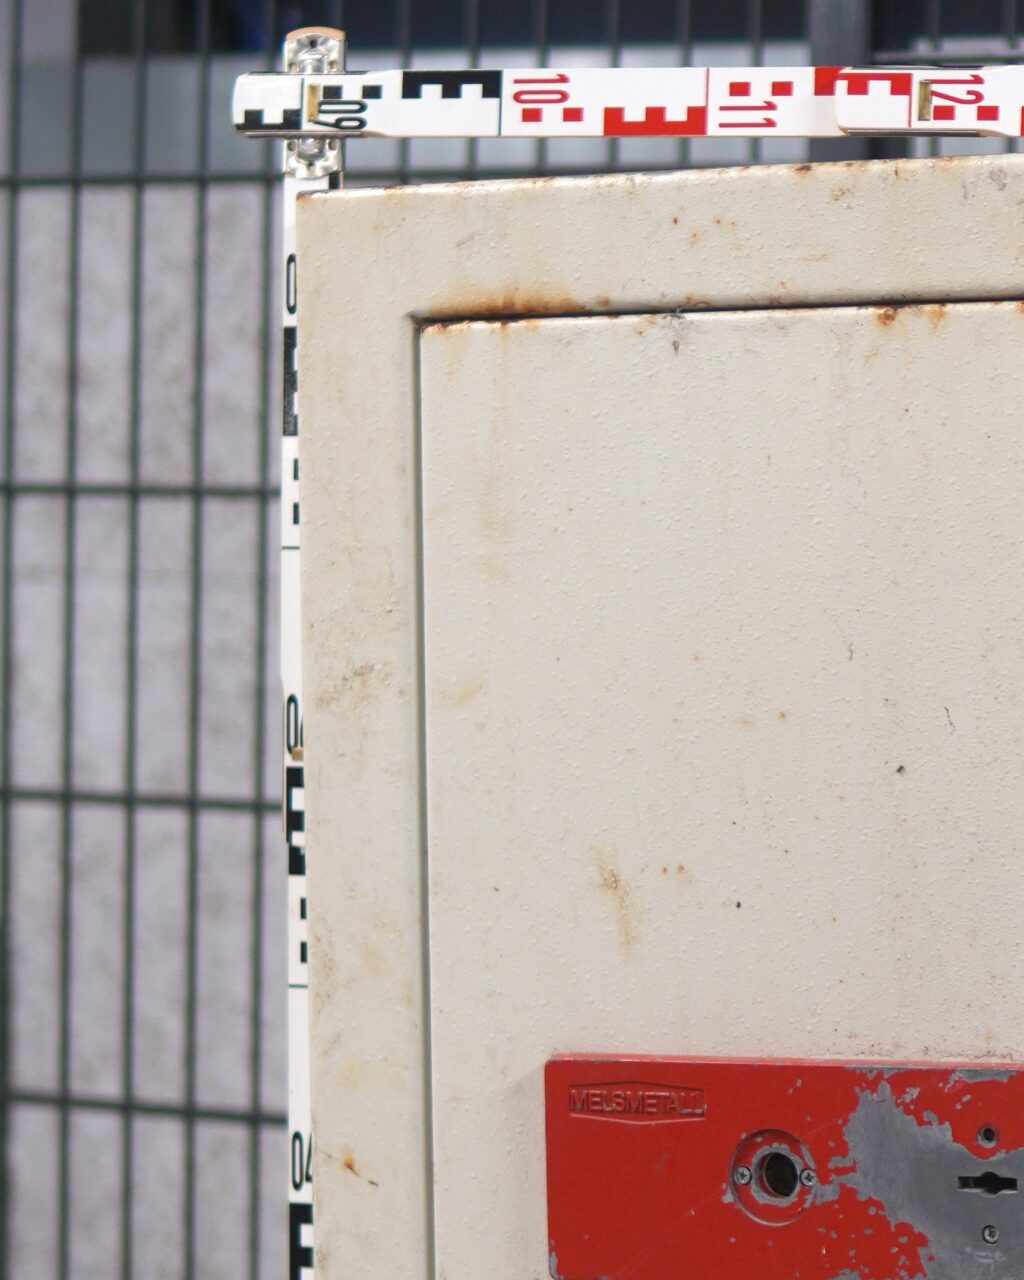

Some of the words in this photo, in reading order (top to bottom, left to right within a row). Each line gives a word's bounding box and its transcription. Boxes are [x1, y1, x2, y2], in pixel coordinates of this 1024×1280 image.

[313, 98, 369, 130] 09
[513, 73, 571, 104] 10
[719, 100, 778, 129] 11
[930, 74, 985, 105] 12
[569, 1089, 705, 1115] MELSMETALL
